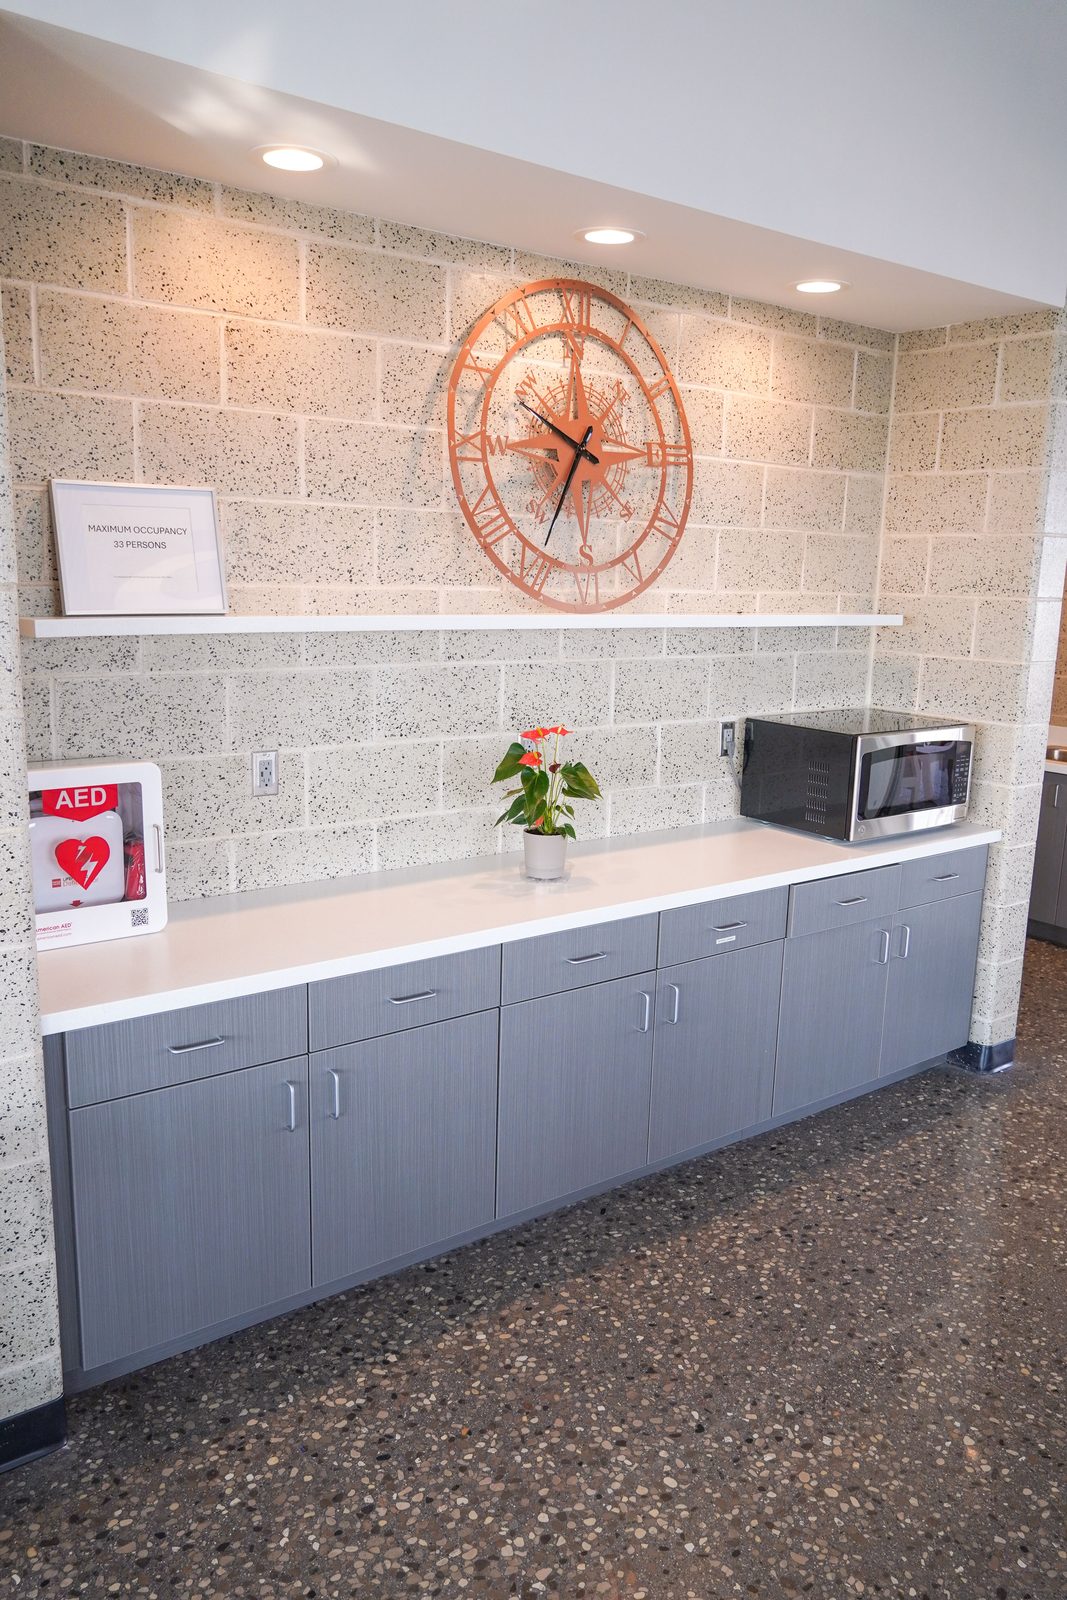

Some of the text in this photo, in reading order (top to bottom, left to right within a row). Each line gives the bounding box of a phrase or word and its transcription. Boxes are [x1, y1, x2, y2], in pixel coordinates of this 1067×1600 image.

[560, 287, 591, 327] XII
[561, 330, 584, 361] N
[514, 370, 538, 401] NW
[486, 434, 510, 457] W
[643, 442, 665, 468] E
[664, 443, 690, 466] III
[526, 499, 551, 524] SW
[619, 500, 636, 523] SE
[88, 524, 187, 536] MAXIMUM OCCUPANCY
[113, 540, 167, 550] 33 PERSONS
[579, 543, 594, 569] S
[55, 787, 107, 810] AED
